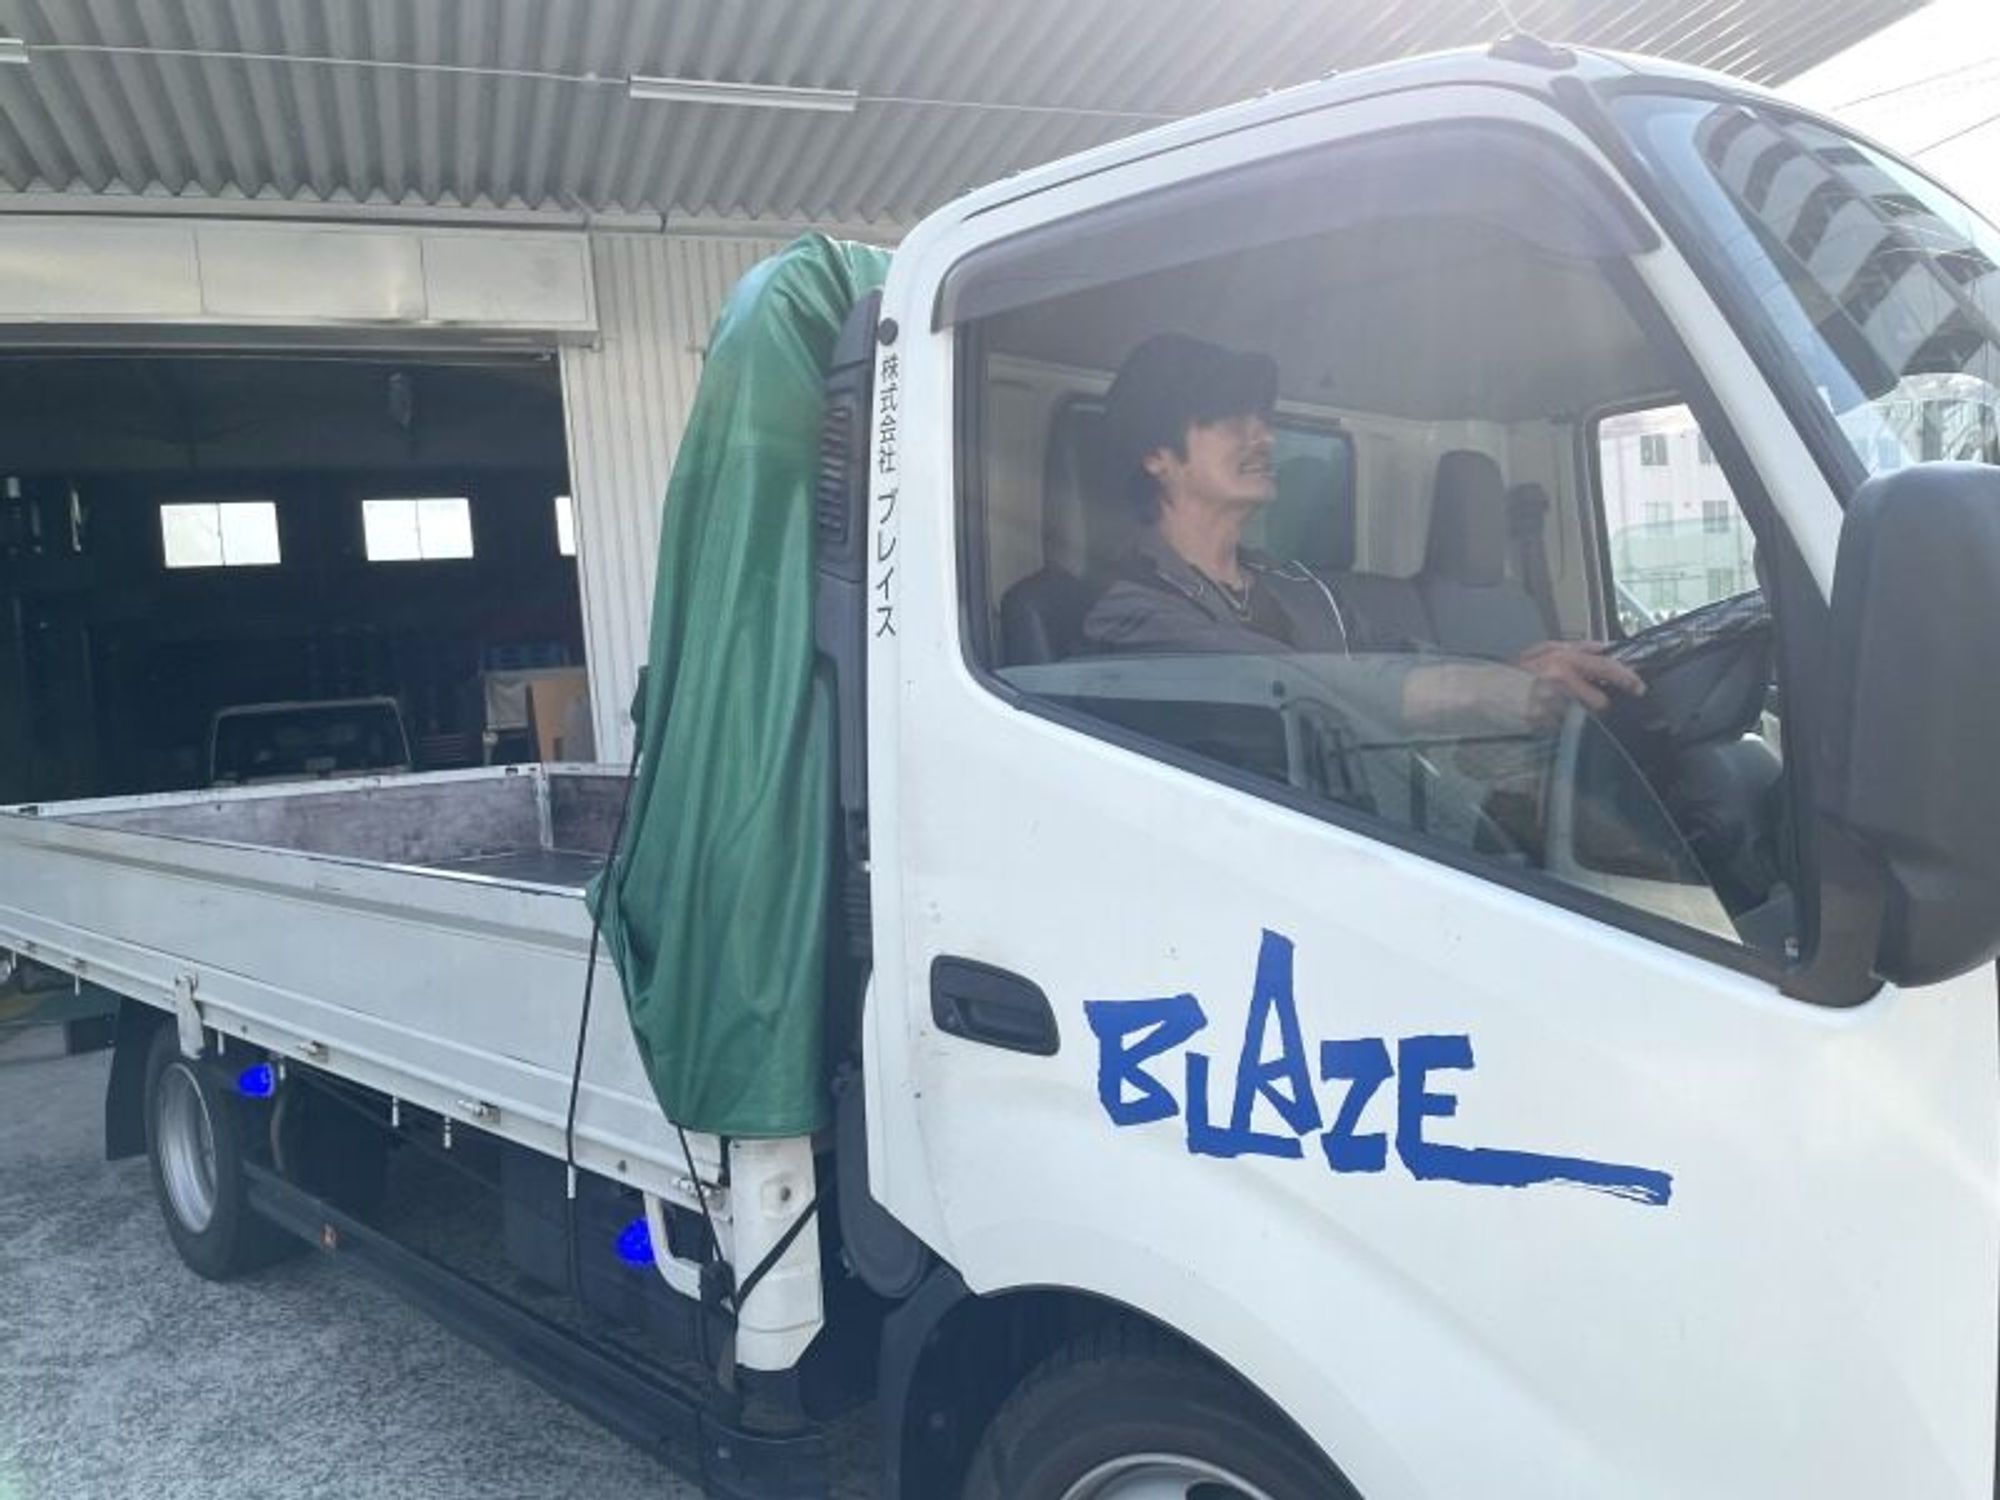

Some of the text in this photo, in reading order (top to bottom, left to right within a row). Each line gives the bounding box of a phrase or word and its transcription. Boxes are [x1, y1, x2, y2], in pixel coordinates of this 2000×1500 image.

[879, 354, 898, 474] 株式会社
[1083, 928, 1673, 1206] BLAZE
